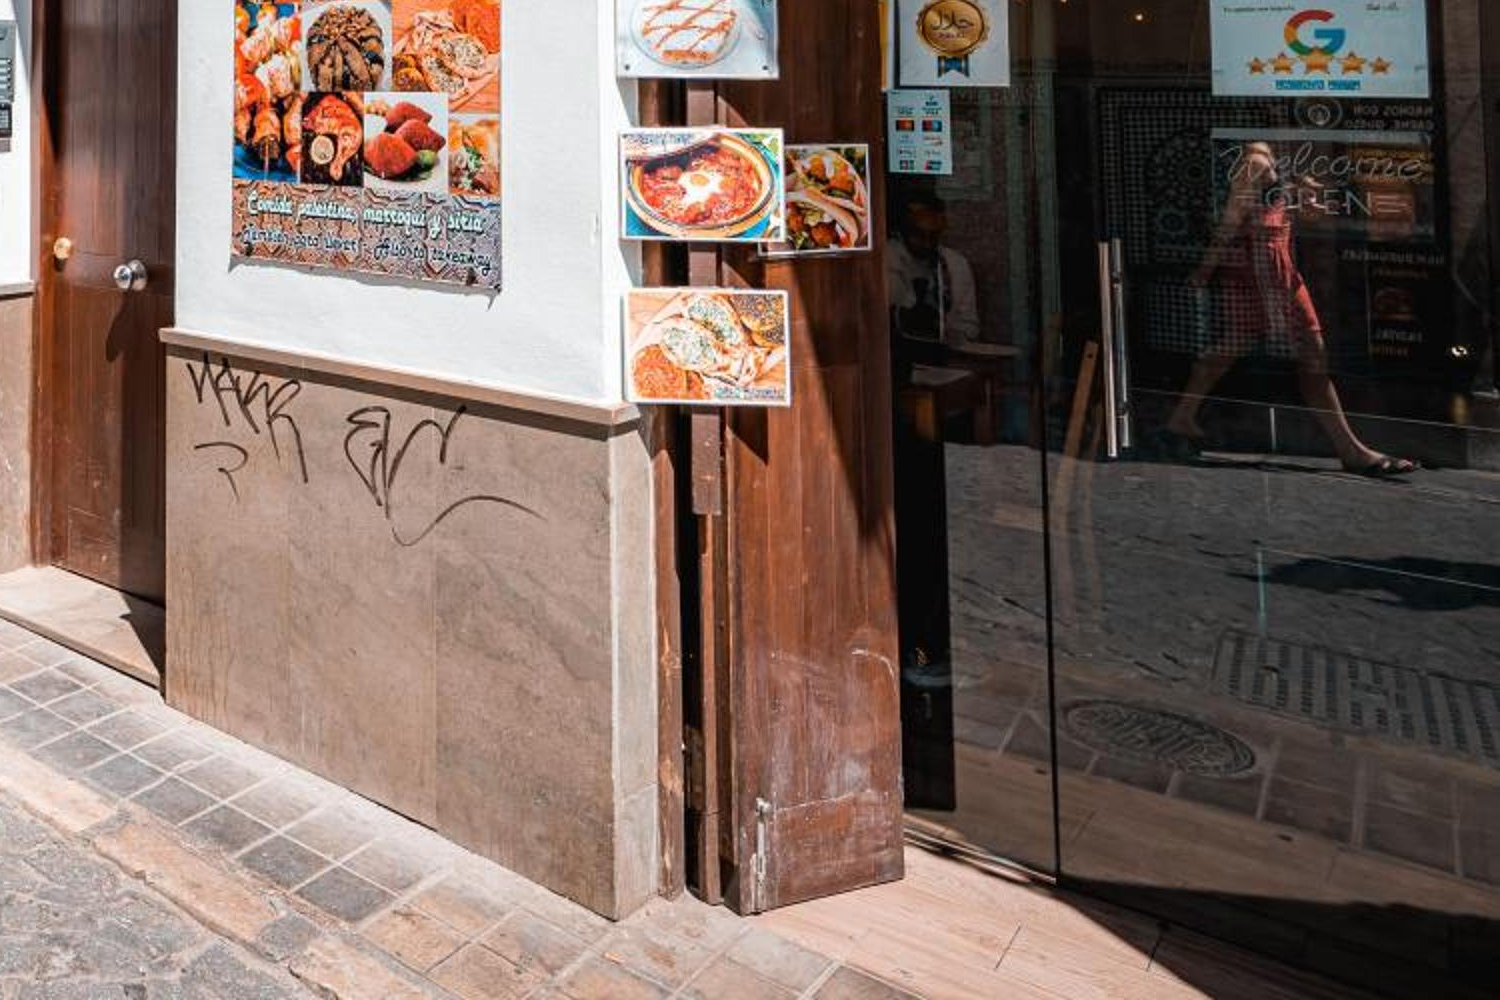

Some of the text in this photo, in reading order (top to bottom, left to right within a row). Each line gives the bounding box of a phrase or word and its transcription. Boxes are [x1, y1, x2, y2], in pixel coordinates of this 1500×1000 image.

[1219, 142, 1424, 182] Welcome
[1266, 187, 1373, 216] OPEN
[430, 214, 442, 239] y
[447, 211, 486, 235] siria
